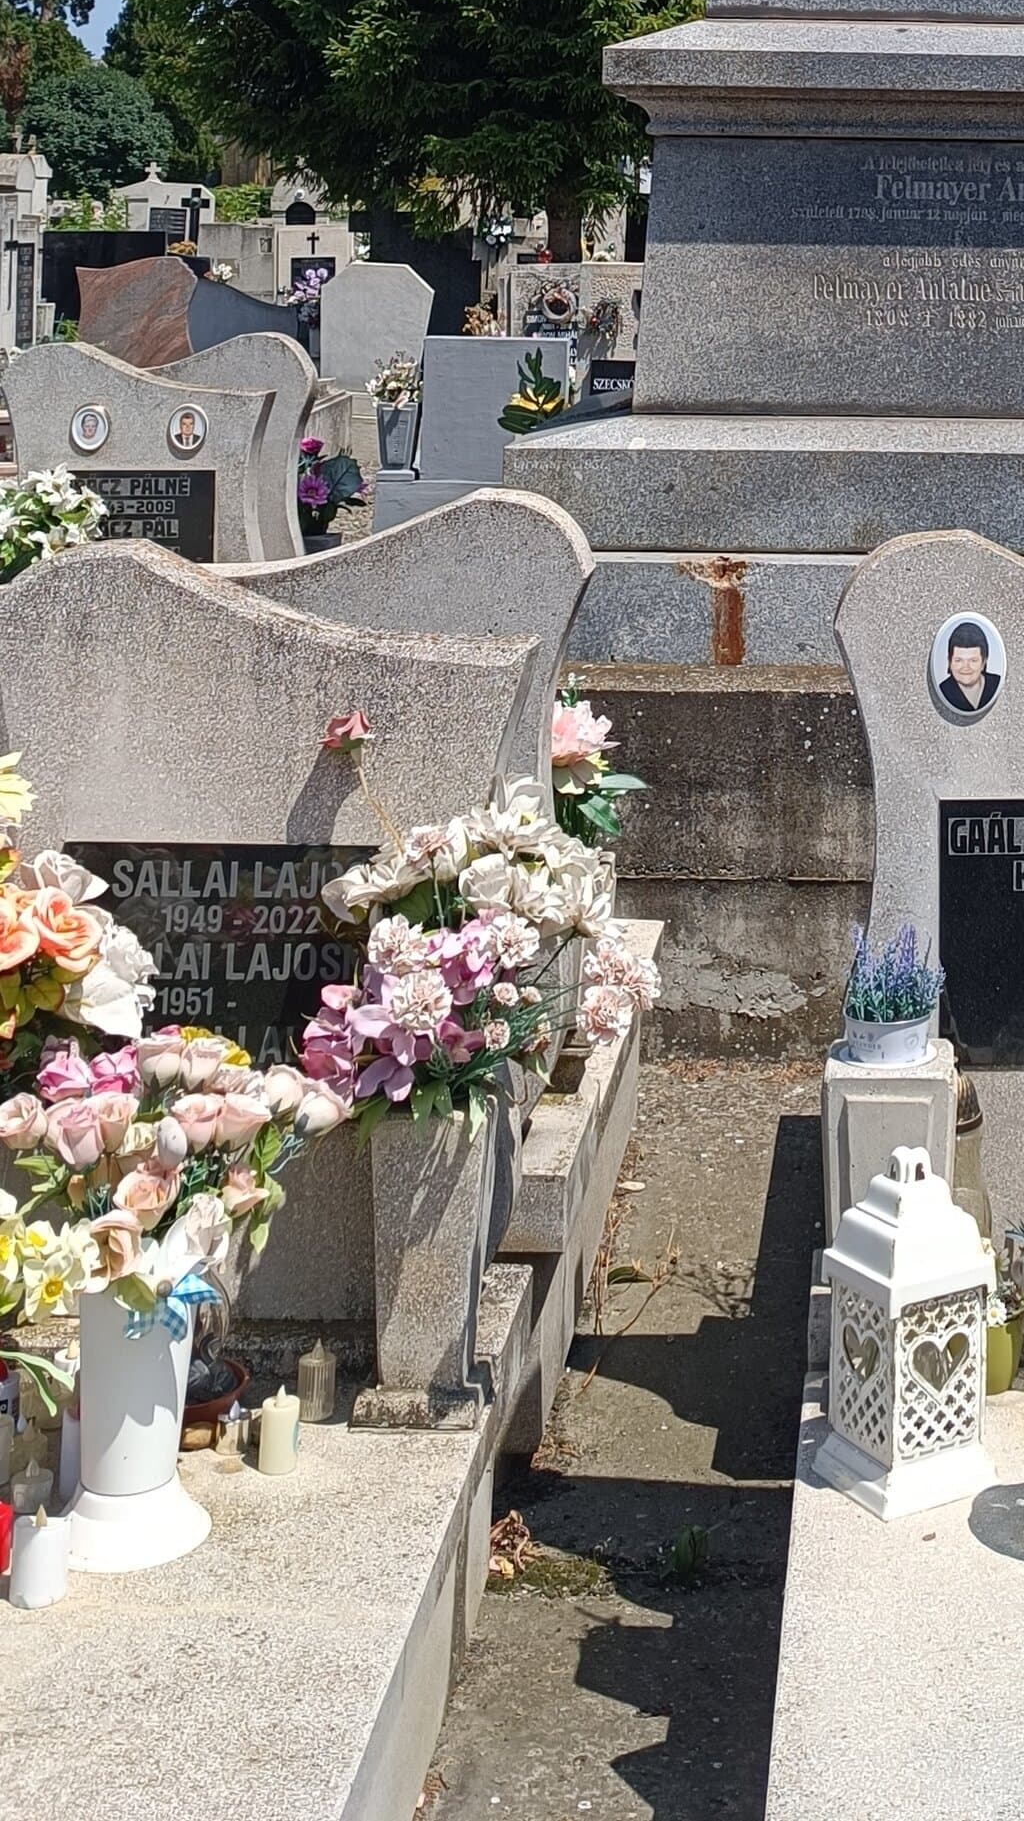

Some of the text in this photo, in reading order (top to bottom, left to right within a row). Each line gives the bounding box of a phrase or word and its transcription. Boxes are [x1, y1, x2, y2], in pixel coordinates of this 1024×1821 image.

[874, 174, 991, 206] Felmayer
[814, 274, 904, 307] Felmayer
[950, 811, 1021, 854] GAÁL
[112, 860, 238, 898] SALLAI
[161, 906, 222, 933] 1949
[252, 905, 321, 934] 2022
[159, 987, 213, 1016] 1951
